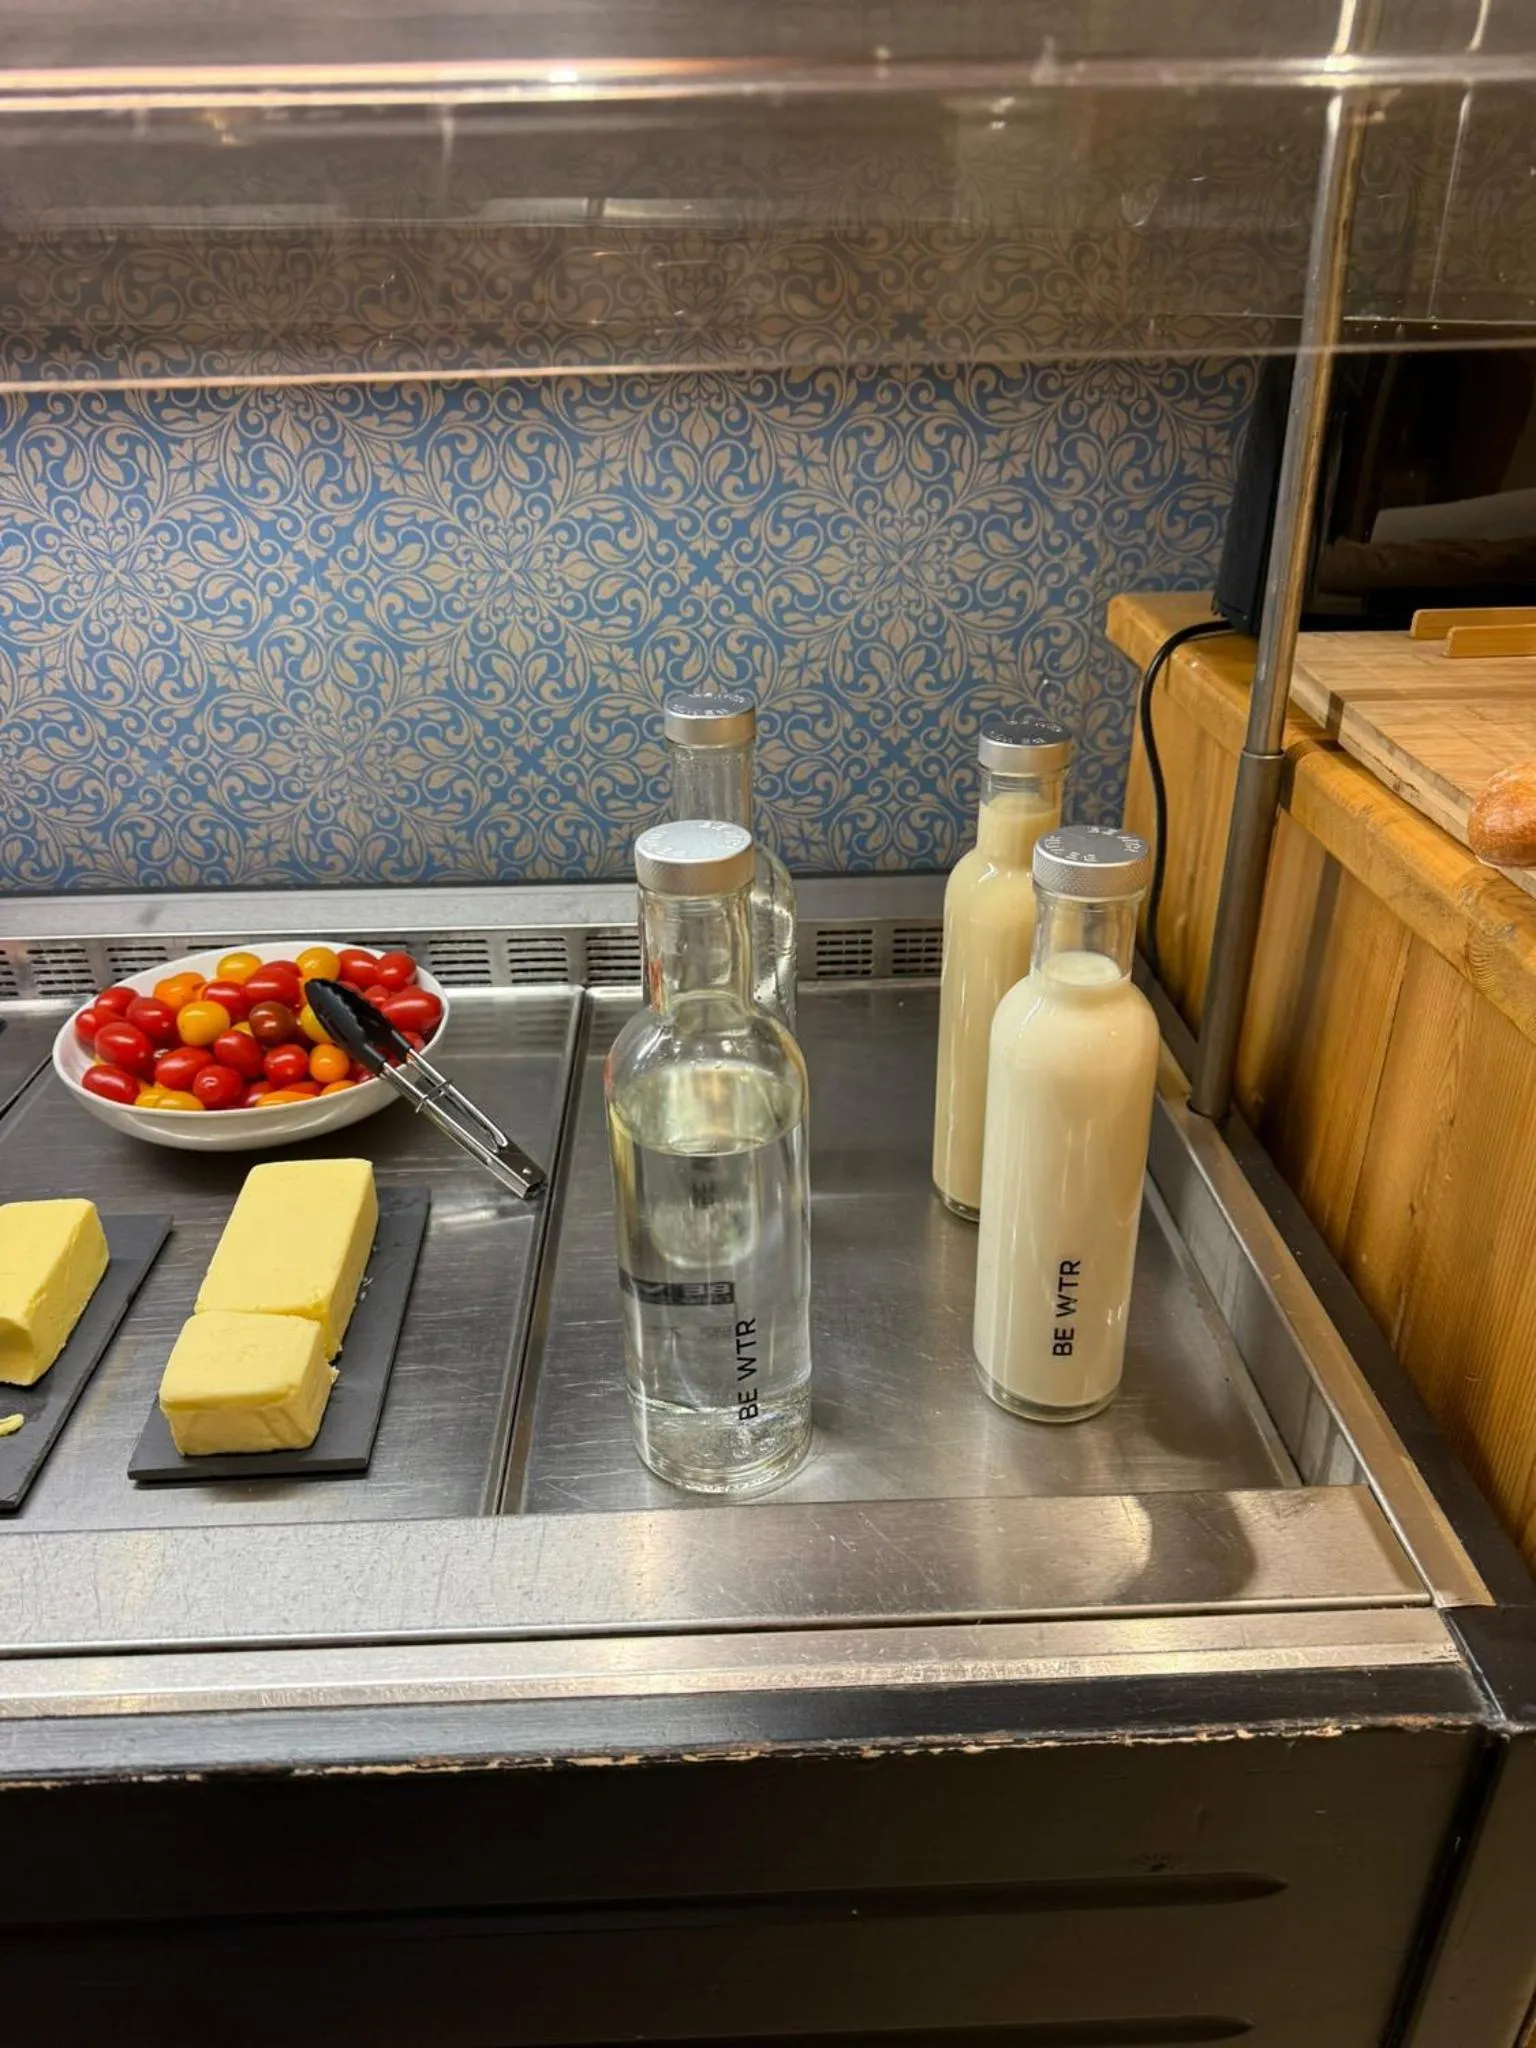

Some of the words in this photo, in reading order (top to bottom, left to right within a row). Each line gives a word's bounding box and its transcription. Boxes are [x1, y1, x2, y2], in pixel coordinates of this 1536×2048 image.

[1055, 1260, 1081, 1318] WTR
[735, 1318, 757, 1381] WTR
[1052, 1327, 1075, 1356] BE
[739, 1388, 758, 1420] BE
